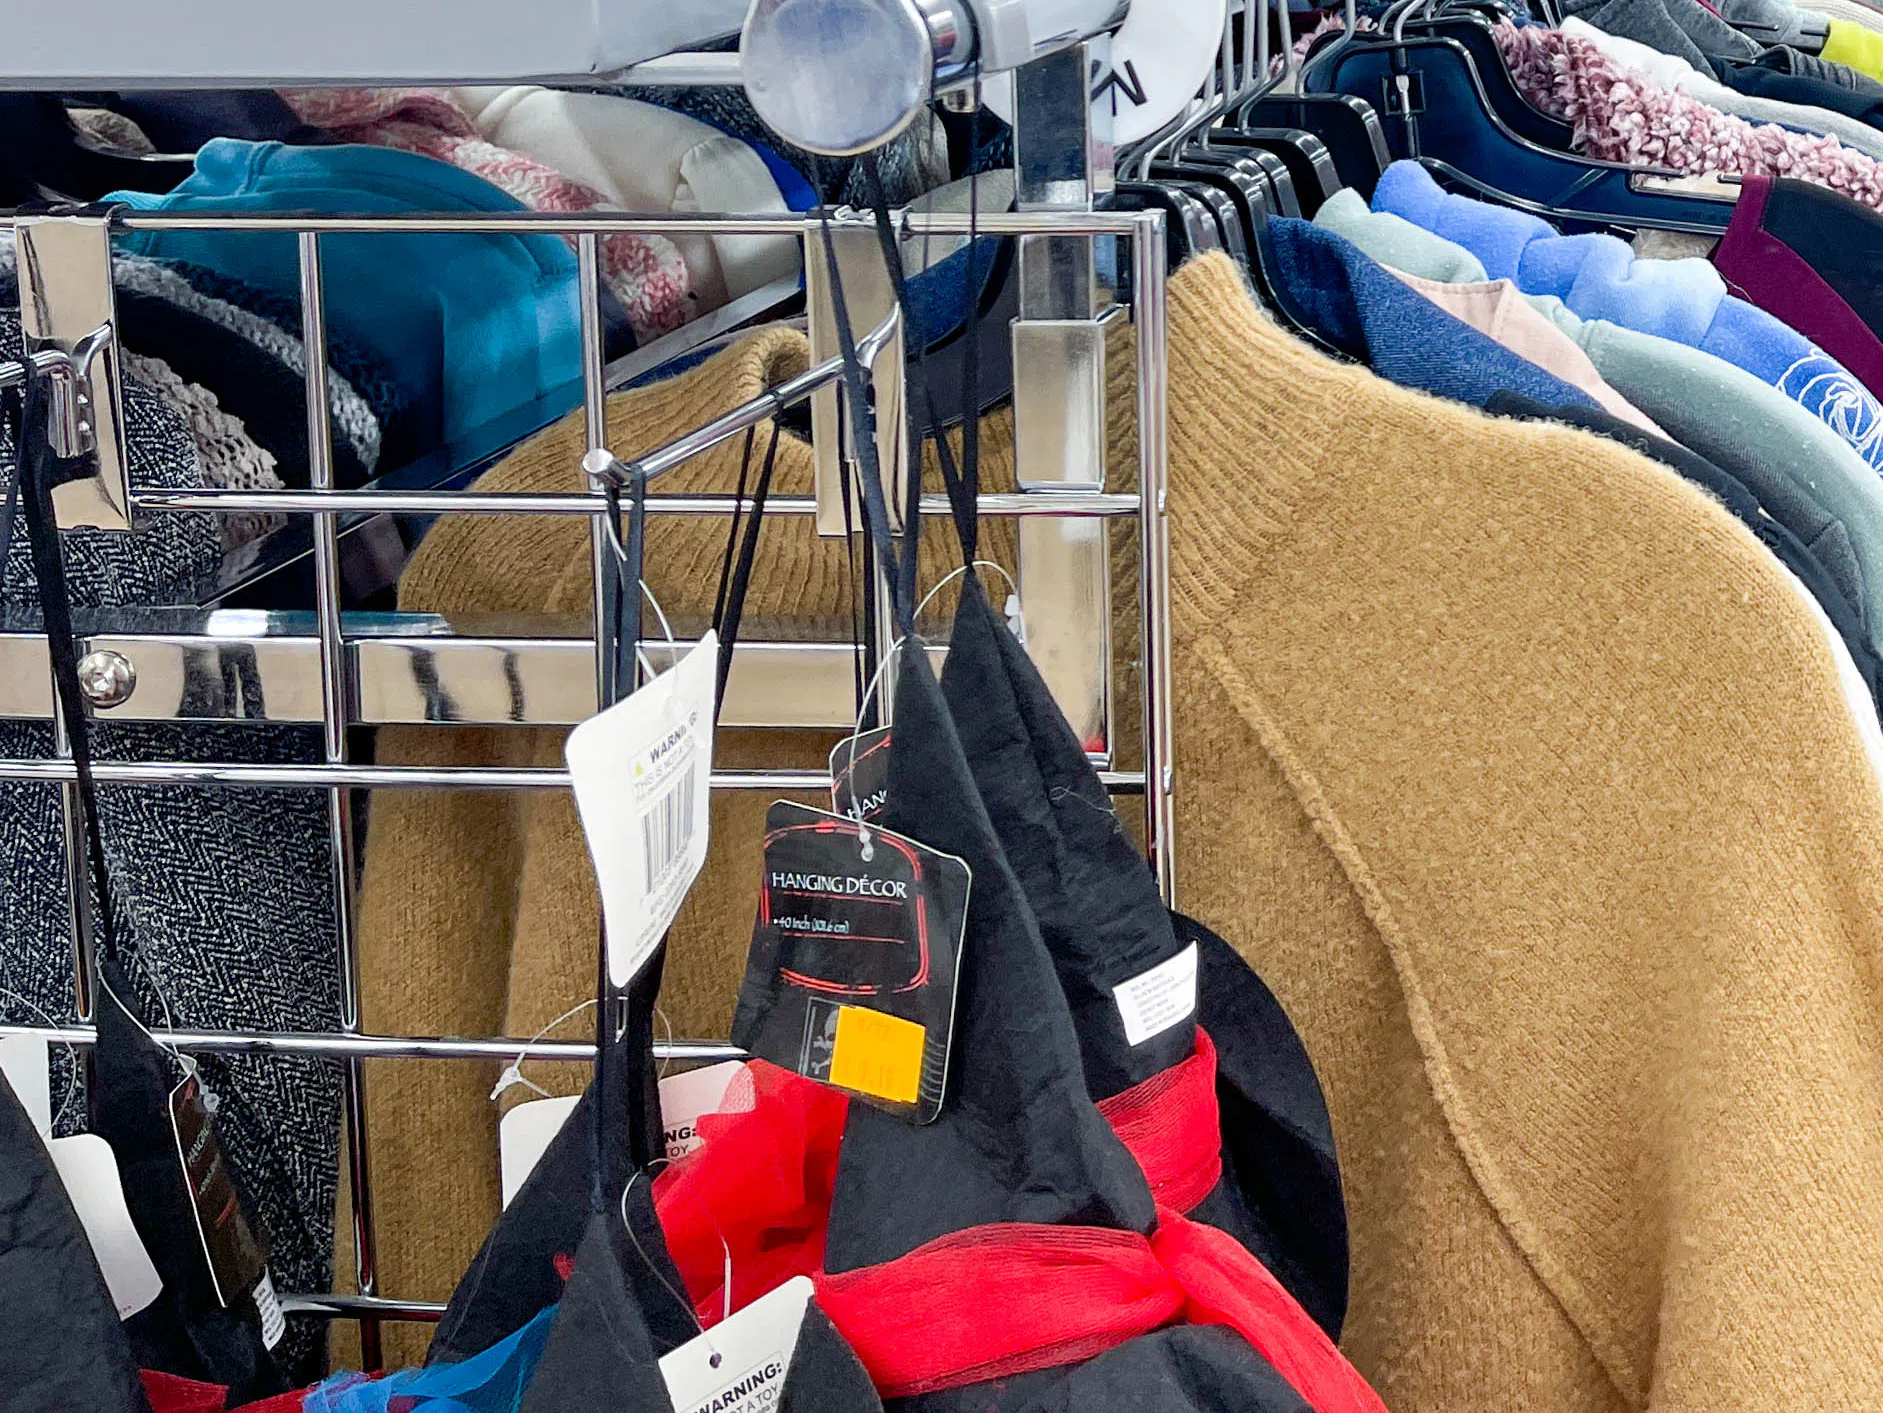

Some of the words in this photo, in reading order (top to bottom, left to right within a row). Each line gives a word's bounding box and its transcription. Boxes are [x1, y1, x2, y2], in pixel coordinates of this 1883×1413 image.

[847, 789, 888, 820] HAN
[772, 872, 843, 894] HANGING
[845, 874, 908, 899] DÉCOR
[664, 1126, 697, 1144] NG:
[670, 1144, 689, 1158] OY
[694, 1361, 783, 1413] WARNING:
[755, 1381, 778, 1406] TOY
